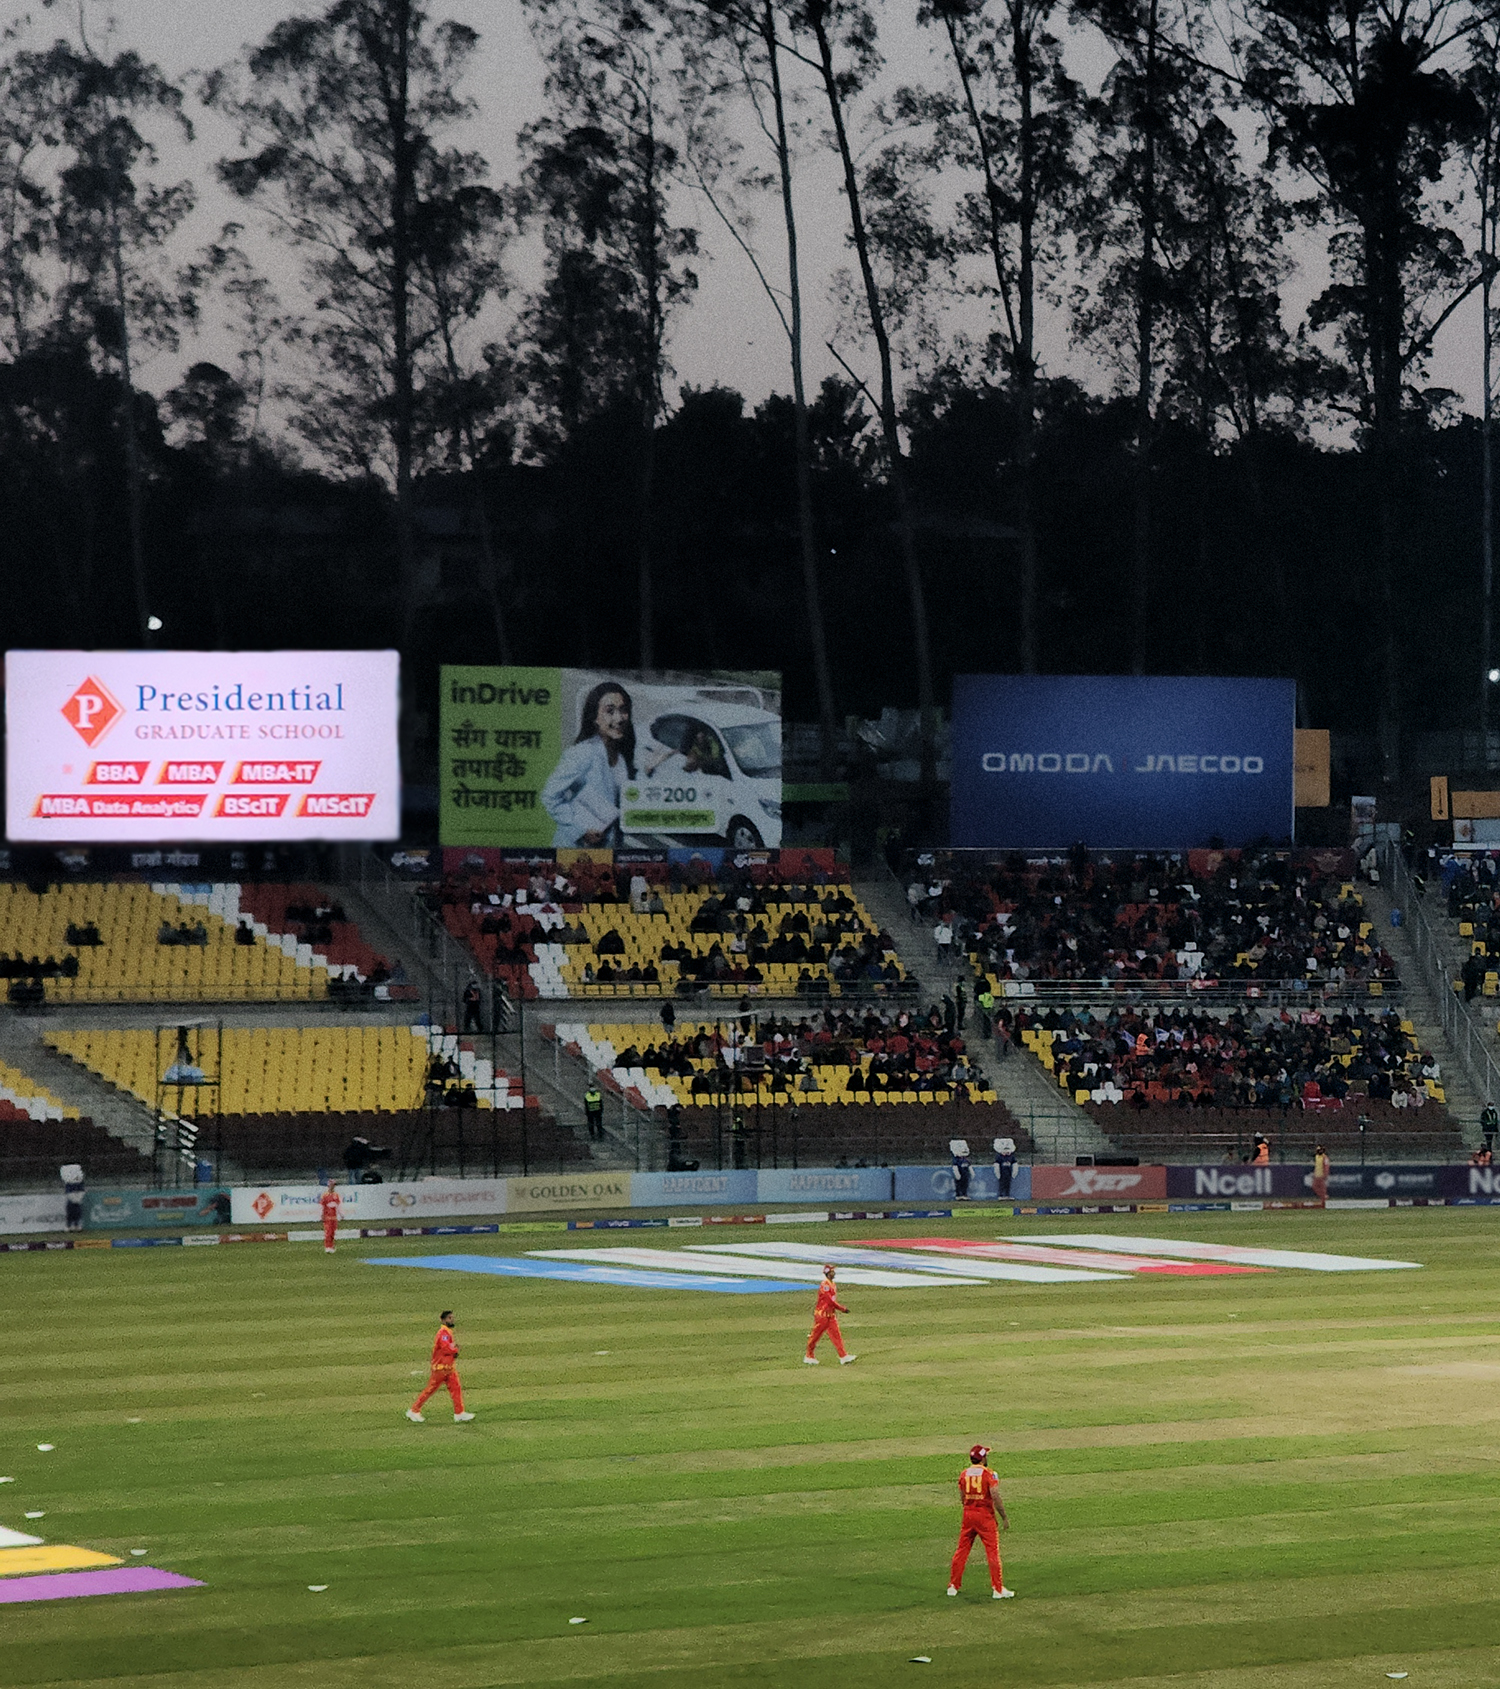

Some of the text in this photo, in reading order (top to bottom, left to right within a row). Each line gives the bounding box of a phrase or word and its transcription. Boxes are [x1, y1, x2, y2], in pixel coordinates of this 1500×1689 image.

[136, 683, 345, 711] Presidential
[451, 680, 550, 706] inDrive
[75, 695, 103, 728] P
[135, 725, 345, 739] GRADUATE SCHOOL
[494, 730, 541, 750] यात्रा
[96, 764, 315, 781] BBA MBA MBA-IT
[982, 752, 1264, 773] OMODA JAECOO
[664, 788, 697, 803] 200
[41, 797, 368, 817] MBA Data Analytics BScIT MScIT
[530, 1183, 622, 1200] GOLDEN OAK
[1195, 1168, 1271, 1196] Ncell
[281, 1192, 359, 1206] Presidial
[964, 1475, 983, 1494] 14
